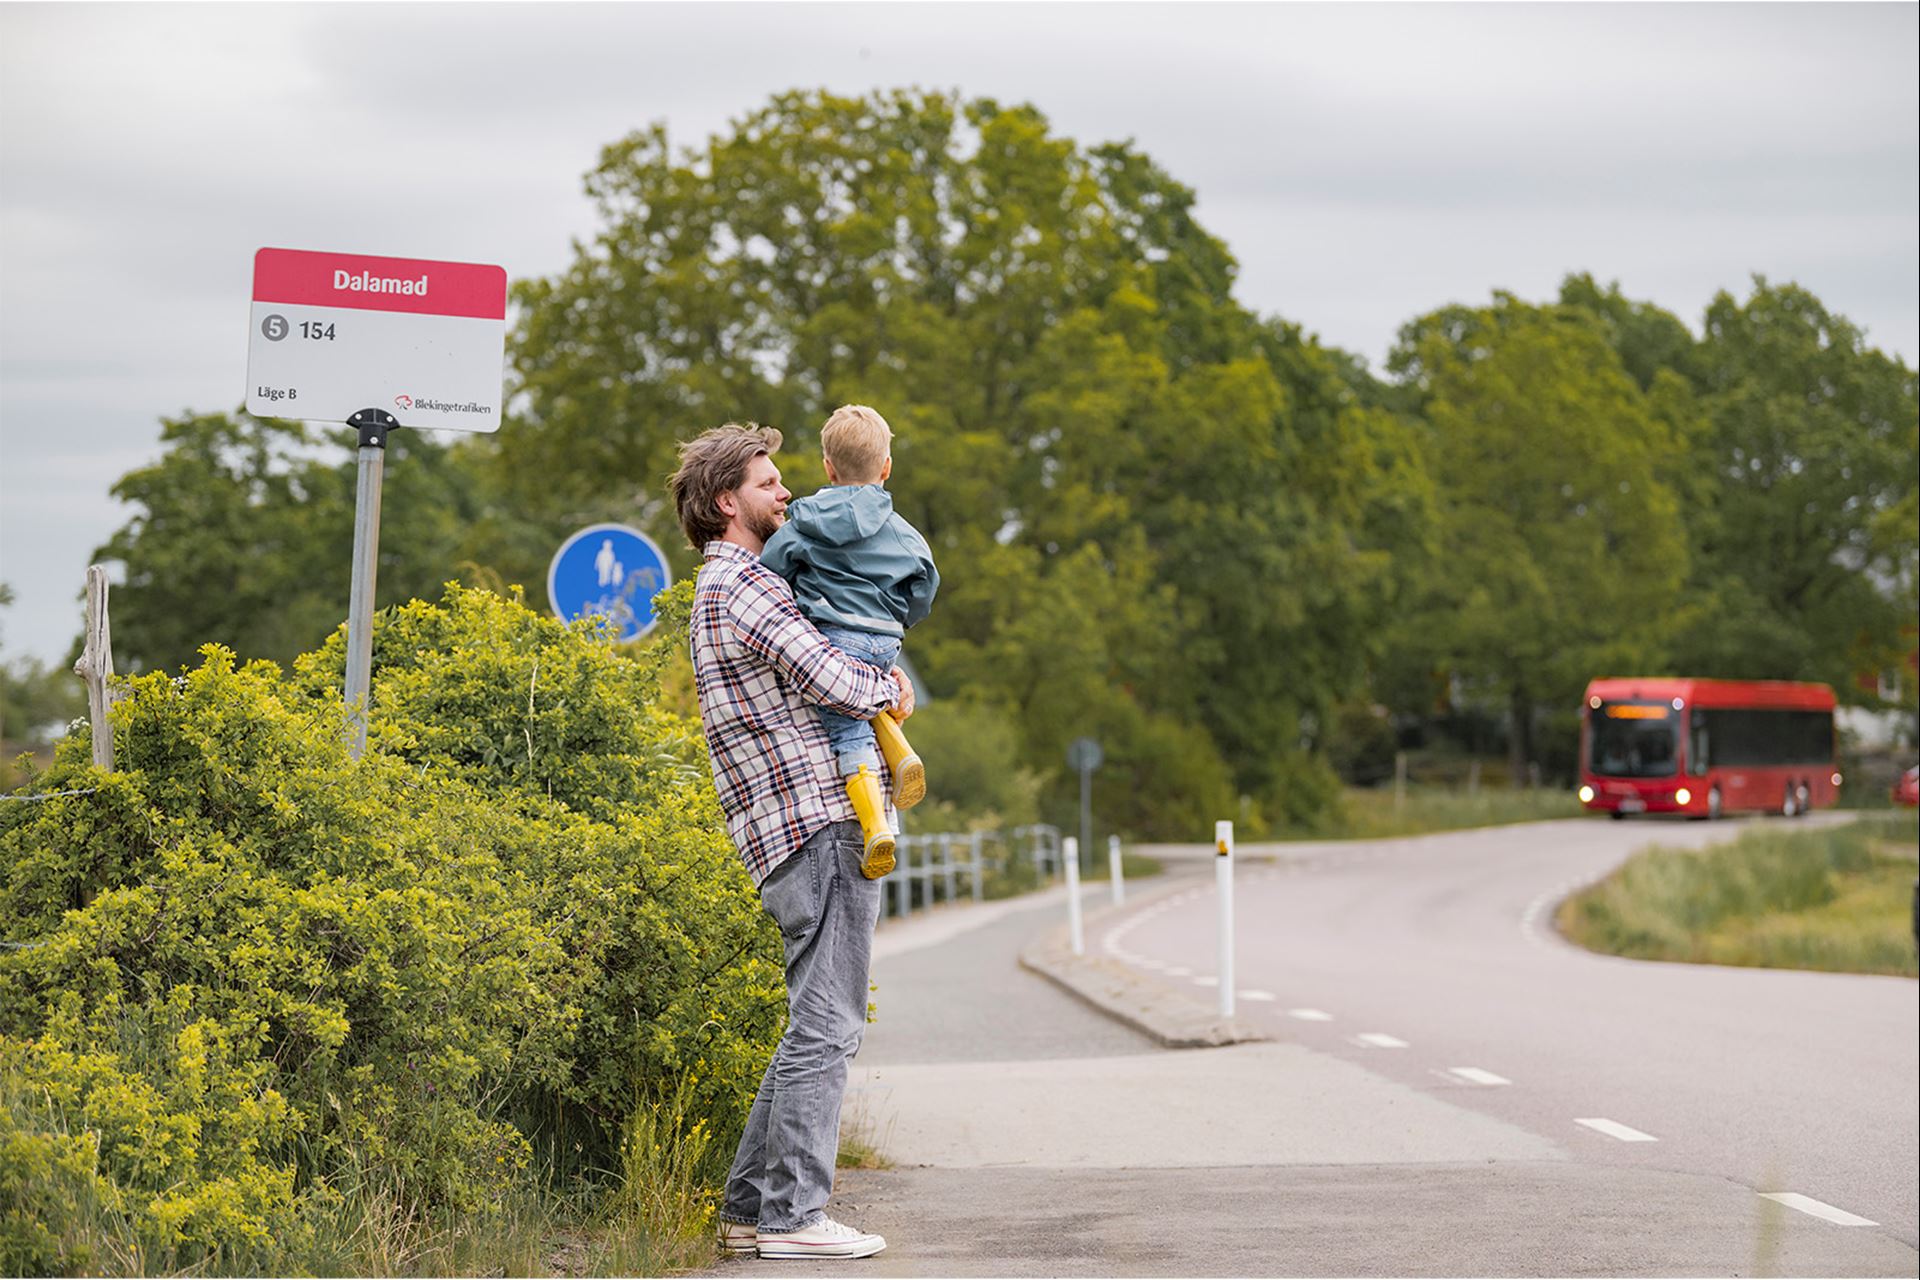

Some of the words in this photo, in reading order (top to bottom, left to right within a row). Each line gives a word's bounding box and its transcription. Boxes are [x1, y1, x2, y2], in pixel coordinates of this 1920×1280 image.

[333, 269, 429, 297] Dalamad
[267, 318, 282, 335] 5
[299, 320, 336, 341] 154
[257, 386, 285, 401] Läge
[288, 388, 297, 399] B
[414, 398, 491, 415] Blekingetrafiken
